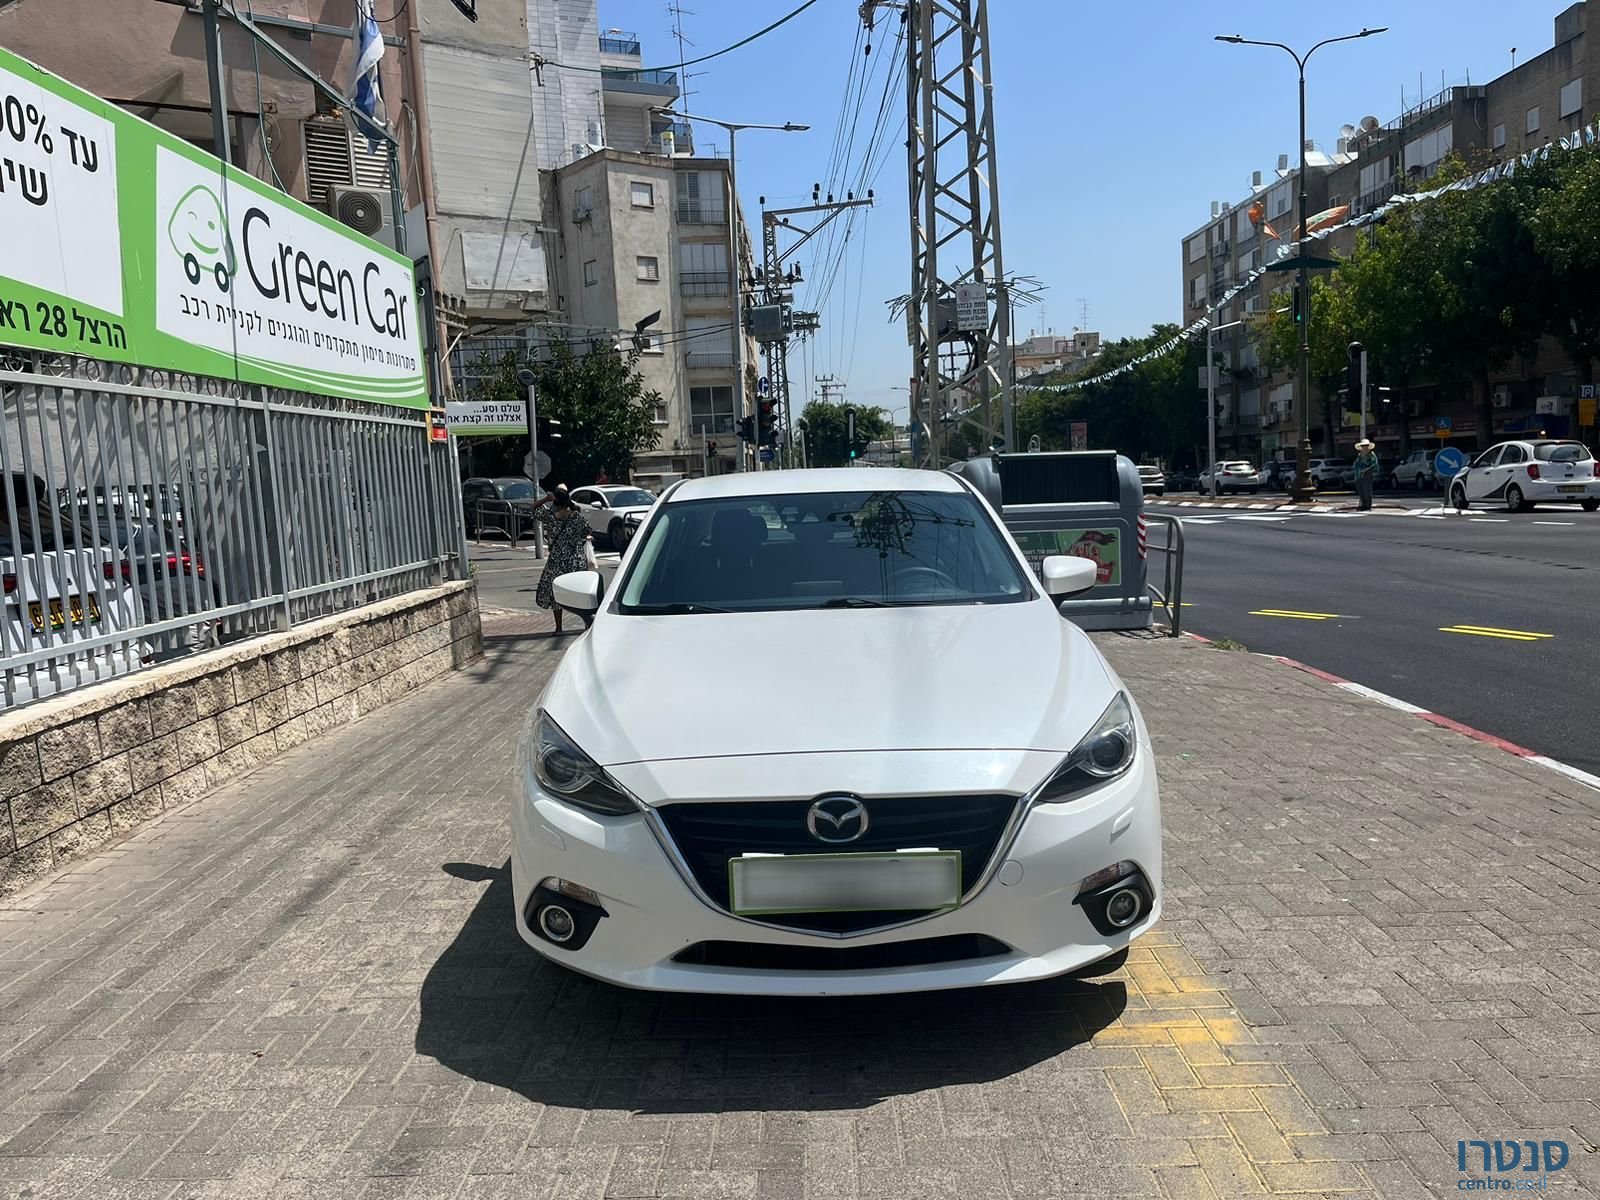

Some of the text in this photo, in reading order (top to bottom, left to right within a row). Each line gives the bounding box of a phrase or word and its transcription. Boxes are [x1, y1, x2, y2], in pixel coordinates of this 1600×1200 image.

[0, 95, 98, 173] עד 0%
[242, 207, 408, 341] Green Car
[36, 301, 67, 338] 28
[72, 307, 127, 350] הרצל
[180, 294, 416, 371] פתרונות מימון מתקדמים והוגנים לקניית רכב
[462, 414, 482, 424] קצת
[473, 403, 521, 413] שלם וסע...
[484, 414, 494, 422] זה
[497, 413, 522, 422] אצלנו
